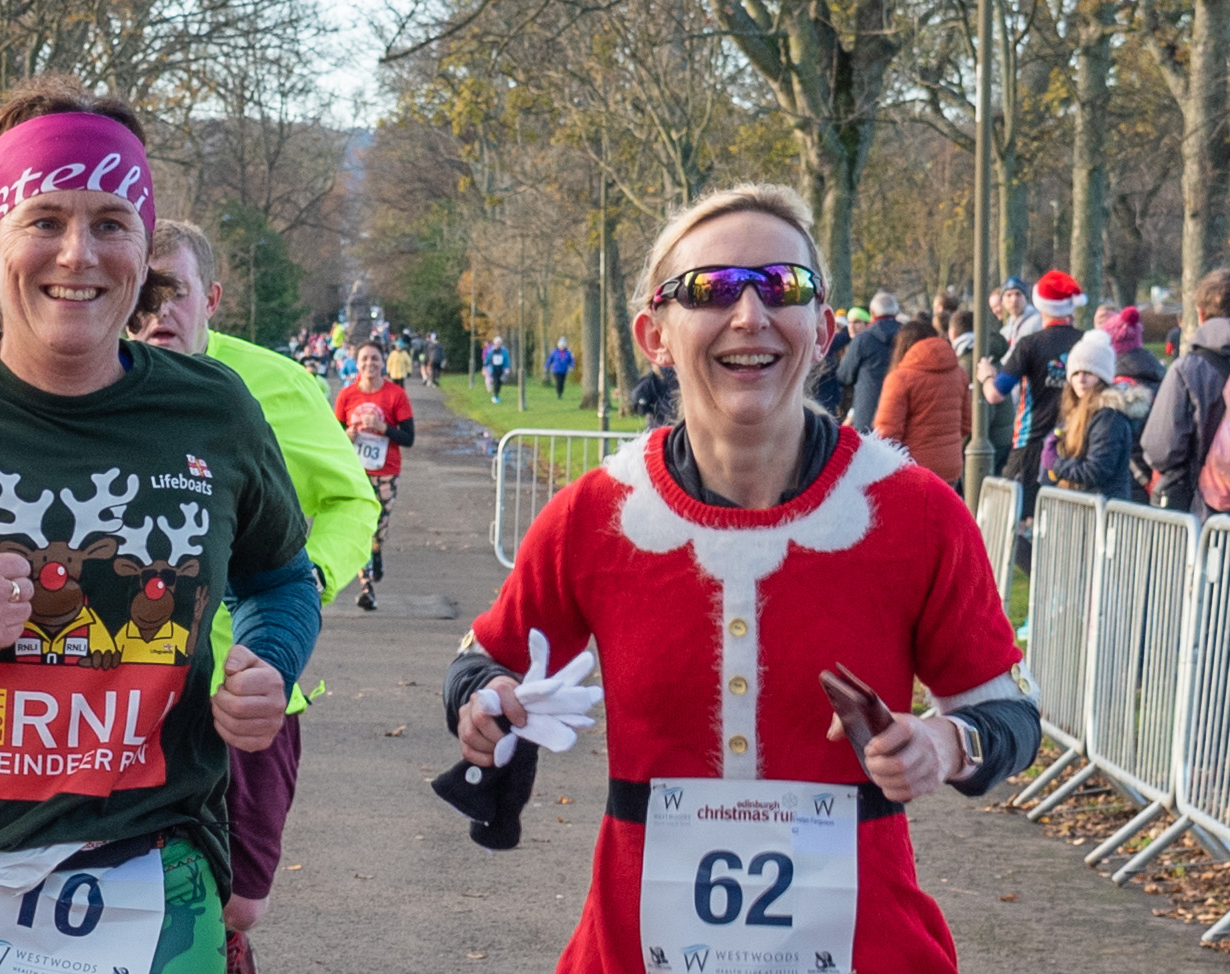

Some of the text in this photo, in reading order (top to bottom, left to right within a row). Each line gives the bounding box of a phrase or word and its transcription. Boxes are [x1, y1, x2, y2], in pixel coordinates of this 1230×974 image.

[357, 443, 381, 460] 103
[150, 473, 213, 496] Lifeboats
[696, 804, 770, 822] christmas
[736, 799, 780, 811] edinburgh
[694, 849, 794, 927] 62
[15, 949, 99, 974] WESTWOODS
[715, 950, 800, 963] WESTWOODS
